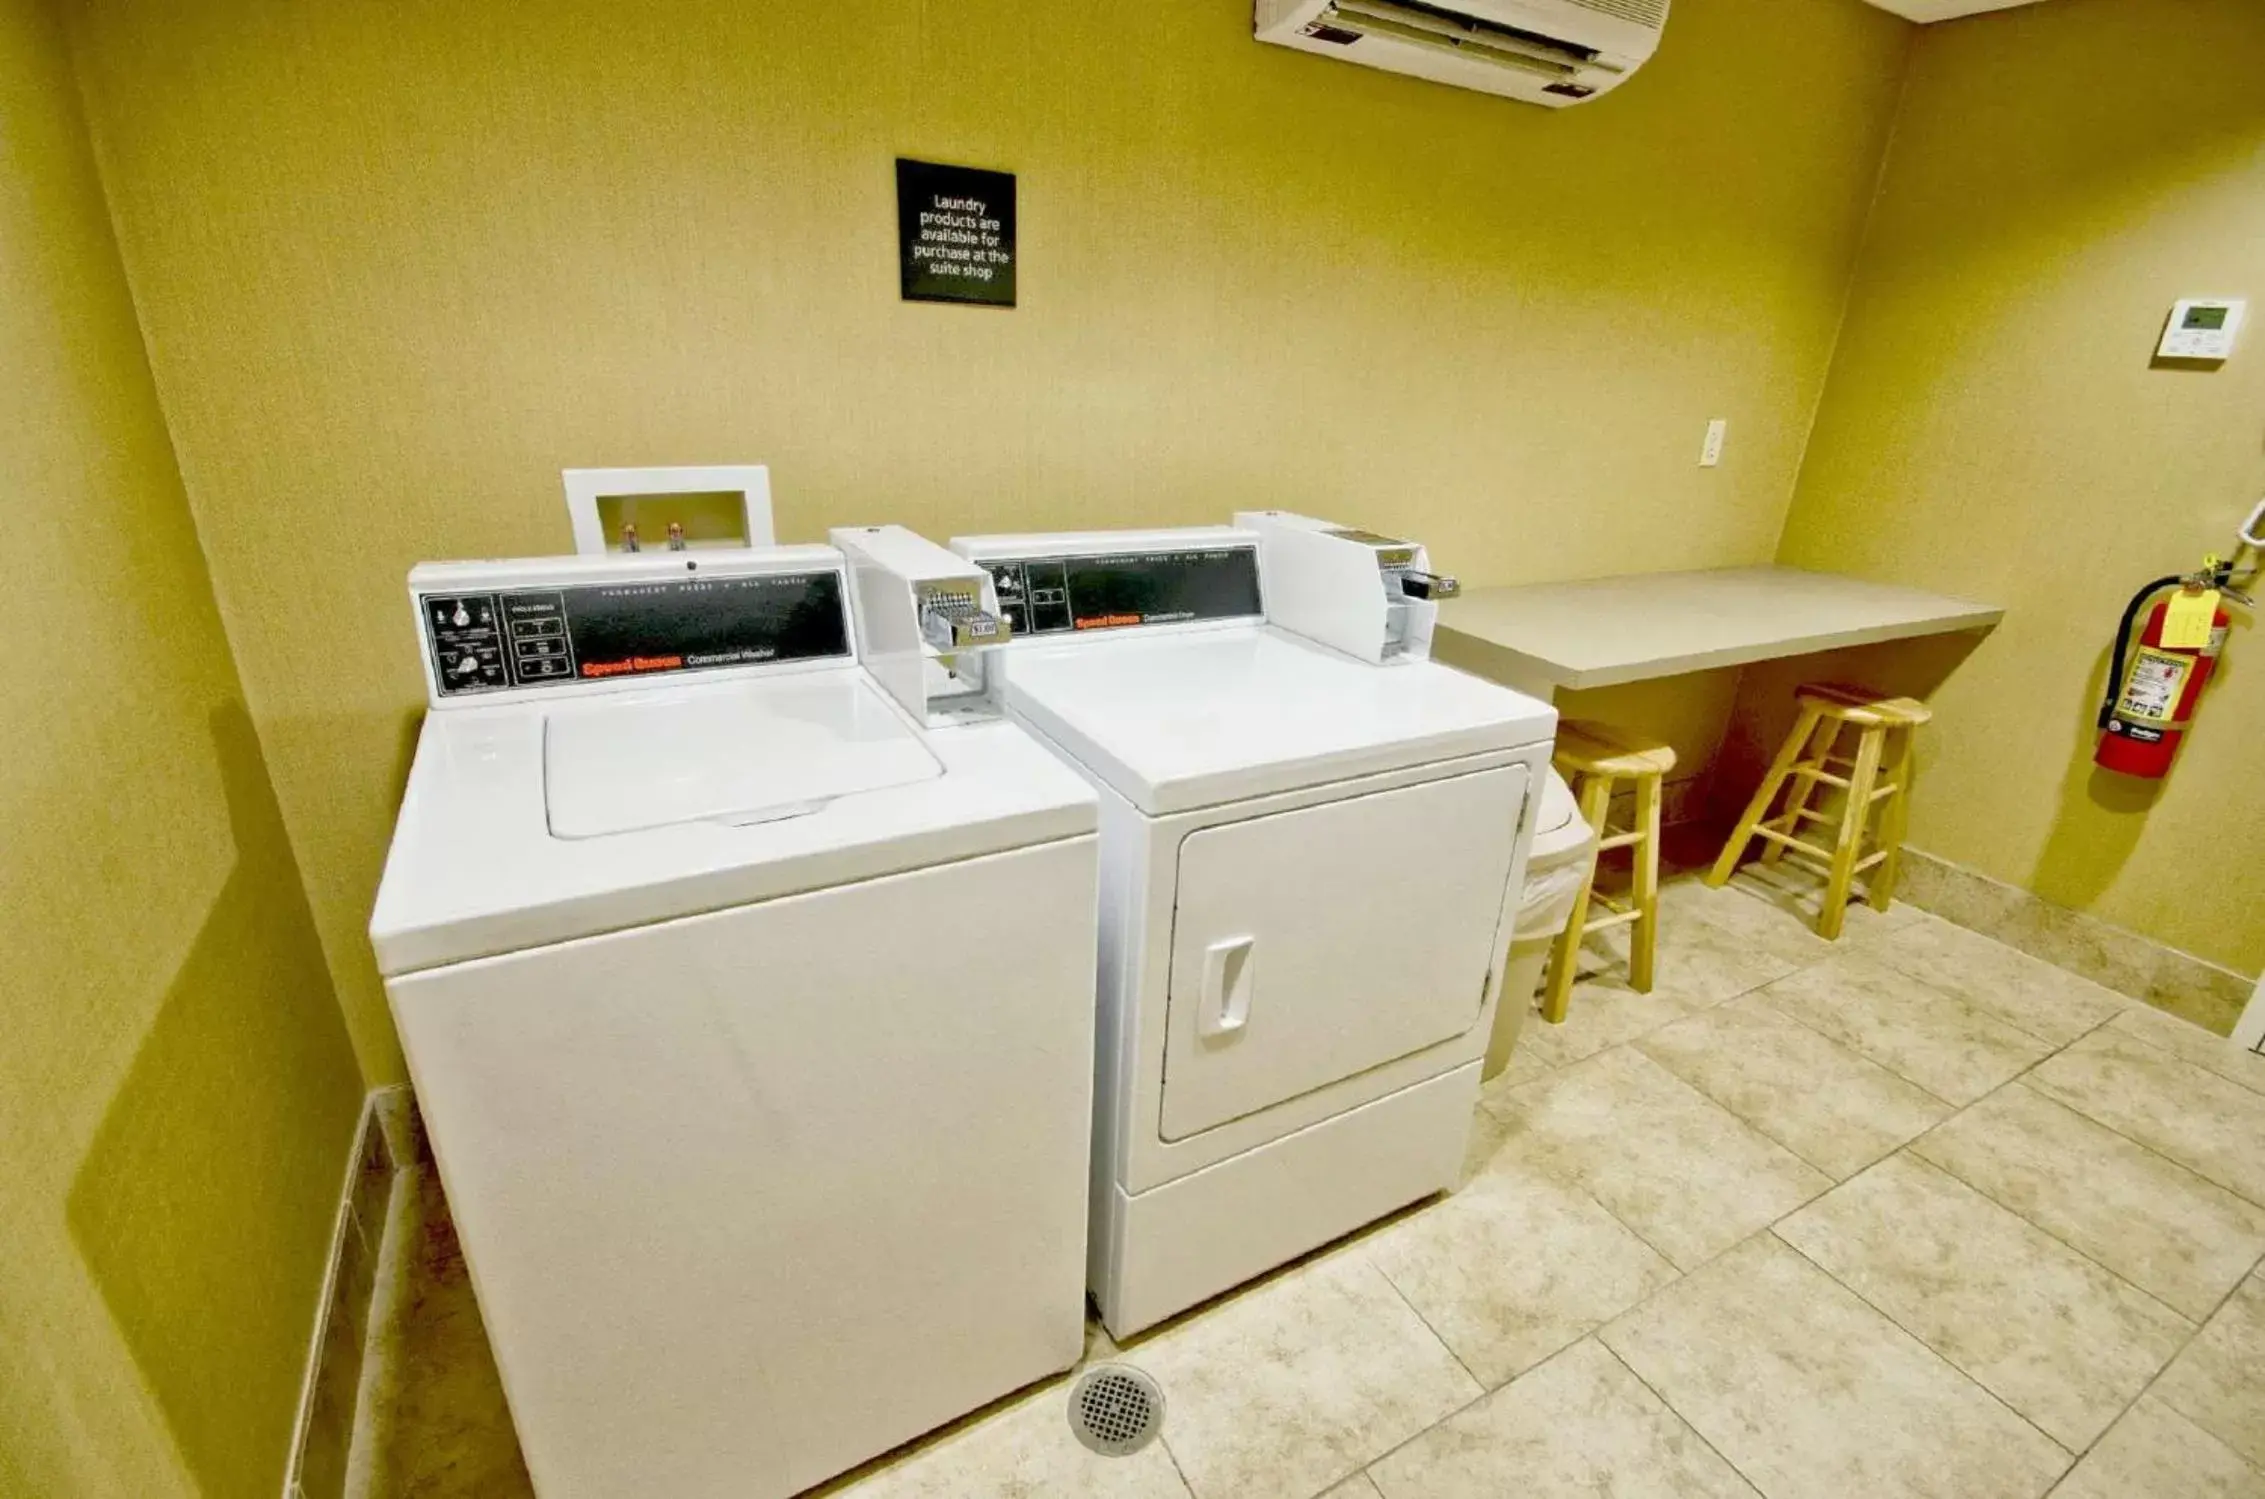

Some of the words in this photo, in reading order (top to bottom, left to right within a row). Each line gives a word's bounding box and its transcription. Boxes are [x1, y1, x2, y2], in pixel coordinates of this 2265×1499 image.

[934, 194, 986, 215] Laundry
[920, 211, 977, 229] products
[979, 218, 1000, 231] are
[921, 228, 978, 245] available
[981, 232, 1000, 247] for
[914, 245, 970, 260] purchase
[973, 248, 985, 262] at
[987, 249, 1009, 263] the
[930, 261, 961, 275] suite
[963, 263, 993, 281] shop
[582, 658, 632, 677] Speed
[687, 651, 741, 666] Commercial
